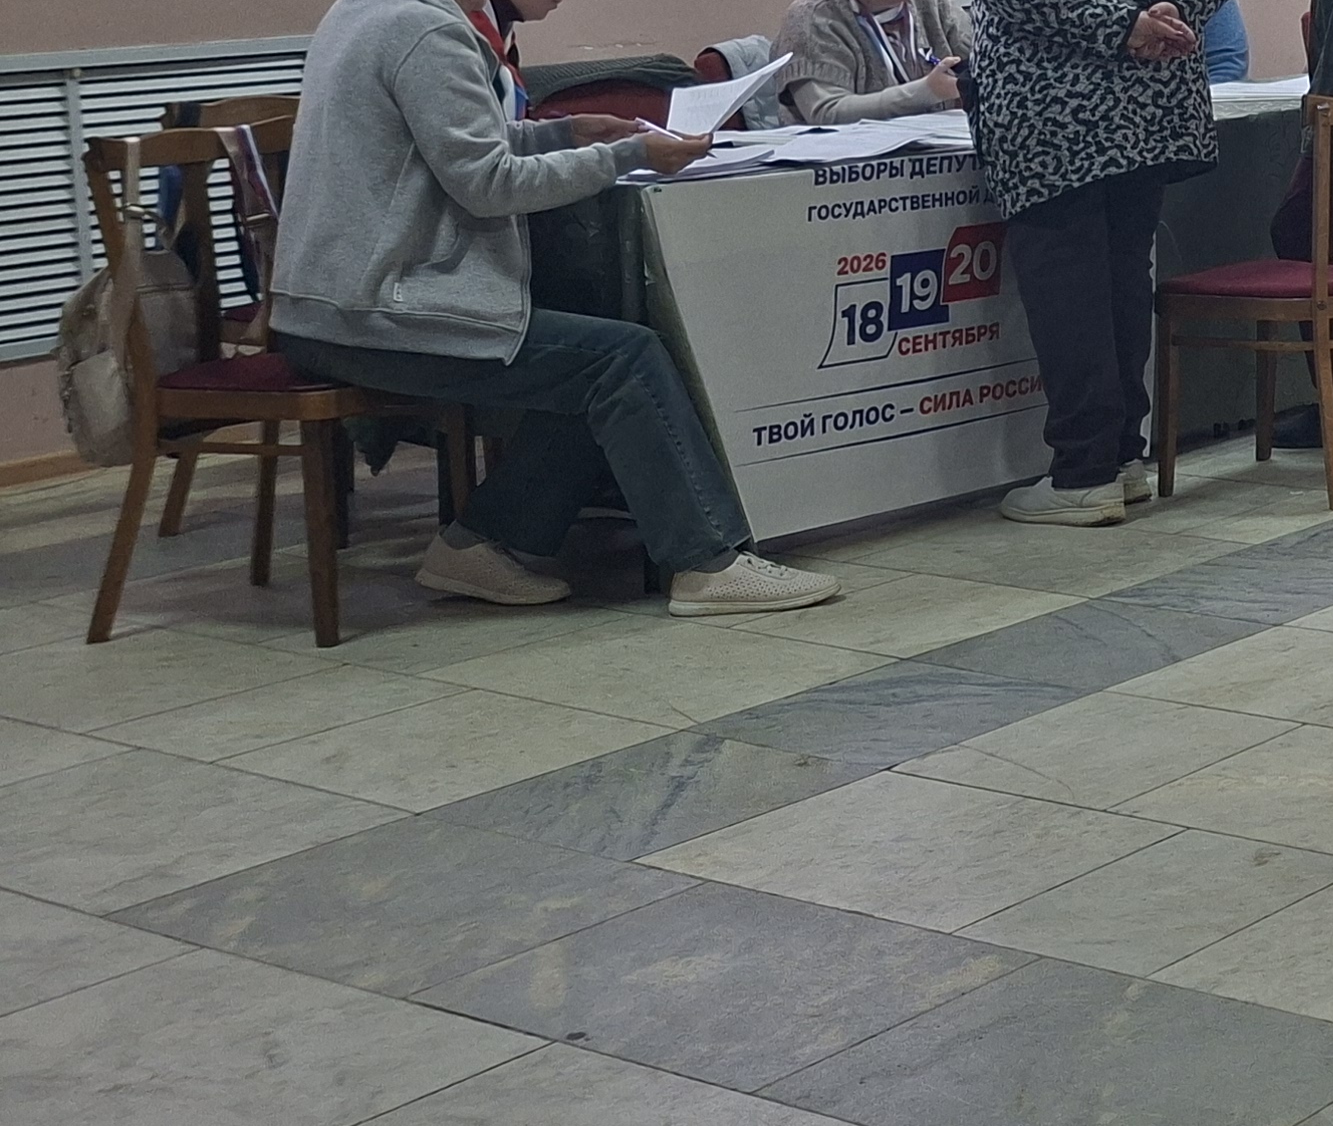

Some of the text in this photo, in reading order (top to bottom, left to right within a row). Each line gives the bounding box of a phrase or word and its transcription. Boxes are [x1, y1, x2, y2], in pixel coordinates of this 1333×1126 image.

[813, 160, 905, 186] ВЫБОРЫ
[807, 185, 980, 222] ГОСУДАРСТВЕННОЙ
[836, 252, 887, 275] 2026
[948, 240, 998, 286] 20
[896, 269, 938, 313] 19
[840, 300, 884, 346] 18
[897, 322, 1000, 357] СЕНТЯБРЯ
[752, 413, 815, 447] ТВОЙ
[822, 403, 896, 434] ГОЛОС
[919, 389, 974, 416] СИЛА
